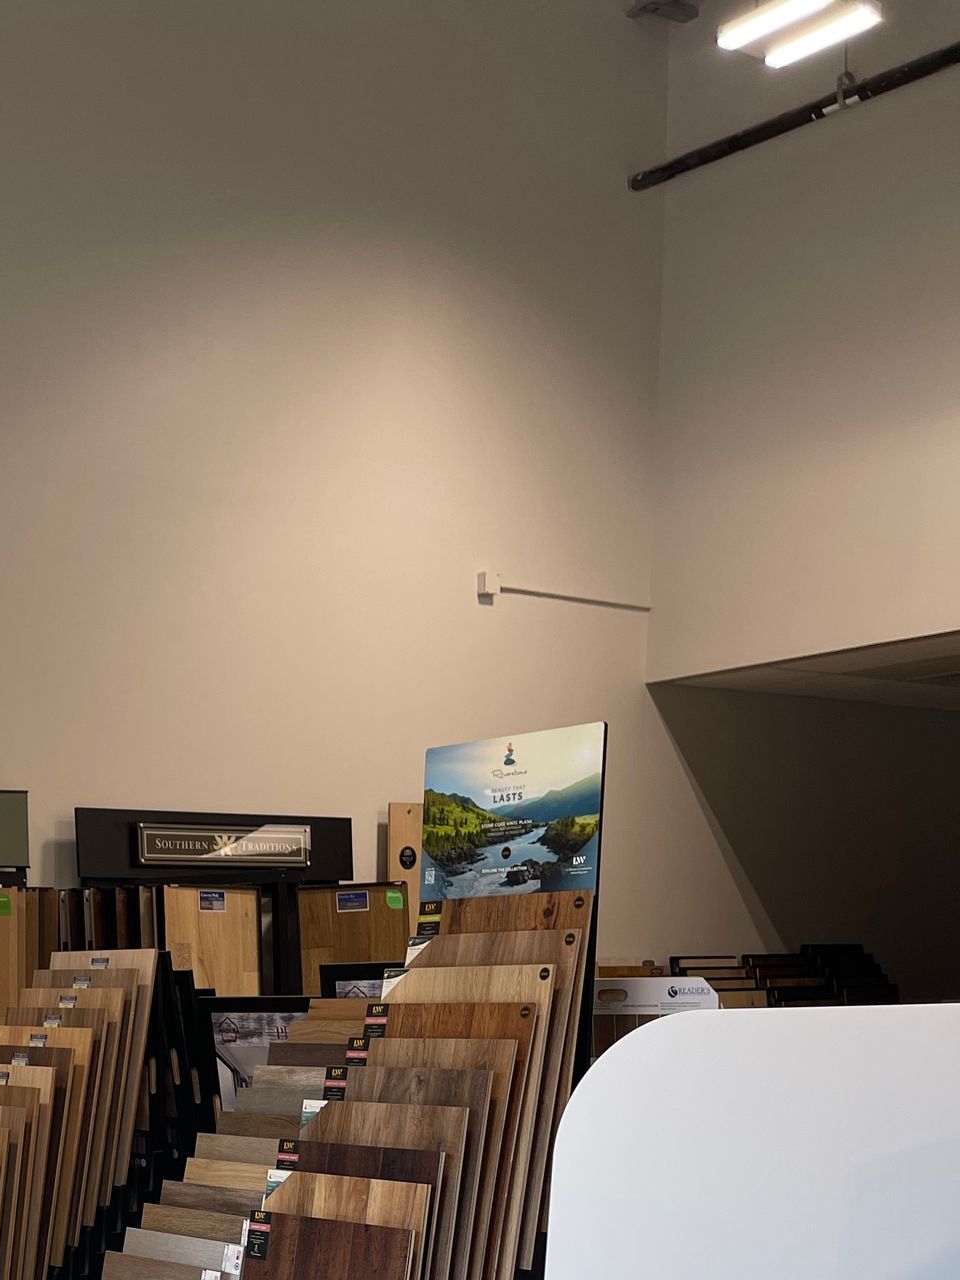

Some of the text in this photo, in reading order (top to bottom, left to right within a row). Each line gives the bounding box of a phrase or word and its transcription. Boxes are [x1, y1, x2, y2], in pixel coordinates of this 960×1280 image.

[493, 792, 523, 803] LASTS
[155, 837, 297, 852] SOUTHERN TRADITIONS
